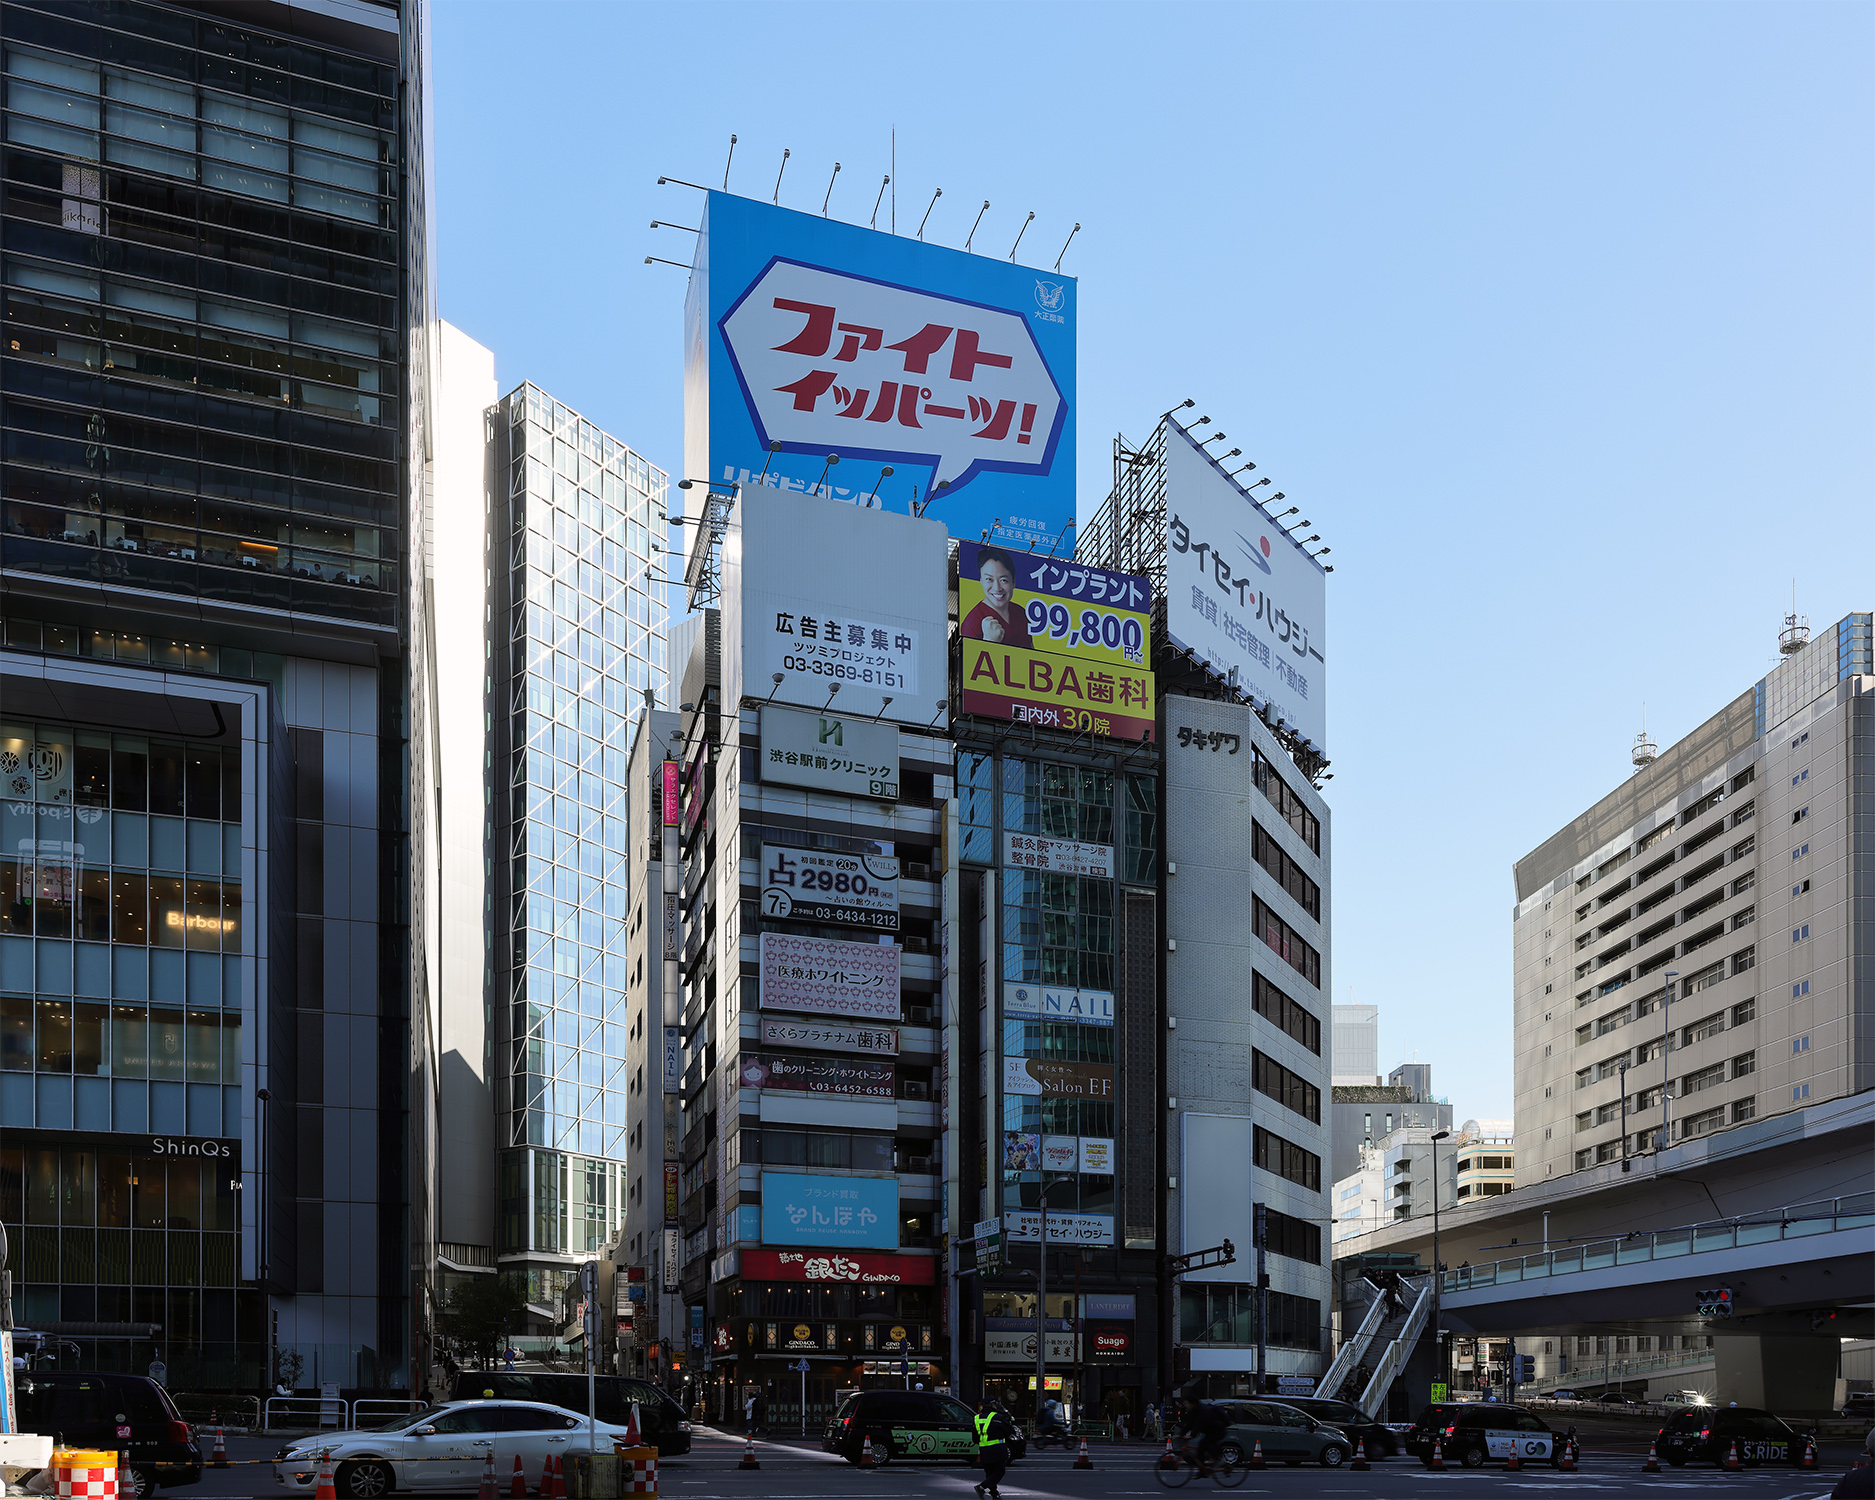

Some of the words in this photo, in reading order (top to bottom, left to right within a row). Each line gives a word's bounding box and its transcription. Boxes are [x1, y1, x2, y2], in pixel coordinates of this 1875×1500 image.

[769, 297, 1013, 382] ファイト
[1009, 516, 1046, 531] 疲労回復
[1030, 563, 1144, 607] インプラント
[775, 612, 912, 655] 広告主募集中
[793, 641, 896, 668] ツツミプロジェクト
[783, 655, 904, 689] 03-3369-8151
[970, 650, 1149, 710] ALBA歯科
[1177, 726, 1241, 755] タキザワ
[769, 748, 892, 778] 渋谷駅前クリニック
[870, 780, 897, 797] 9階
[1011, 851, 1050, 868] 整骨院
[1055, 842, 1108, 857] マッサージ院
[769, 852, 798, 887] 占
[166, 911, 235, 931] Barbour
[768, 894, 787, 915] 7F
[815, 907, 897, 927] 03-6434-1212
[778, 965, 885, 987] 医療ホワイトニング
[1046, 993, 1113, 1017] NAIL
[767, 1025, 893, 1051] さくらプラチナム歯科
[667, 1046, 675, 1077] NAIL
[771, 1061, 893, 1081] 歯のクリーニング・ホワイトニング
[816, 1082, 892, 1096] 03-6452-6588
[1043, 1078, 1083, 1094] Salon
[1089, 1077, 1112, 1096] EF
[152, 1137, 231, 1158] ShinQs
[804, 1188, 859, 1200] ブランド買取
[785, 1204, 878, 1227] なんぼや
[778, 1252, 804, 1264] 築地
[803, 1254, 861, 1281] 銀だこ
[989, 1341, 1019, 1349] 中国酒場
[1097, 1336, 1125, 1346] Suage
[1525, 1441, 1546, 1456] GO
[1743, 1445, 1789, 1460] S.RIDE
